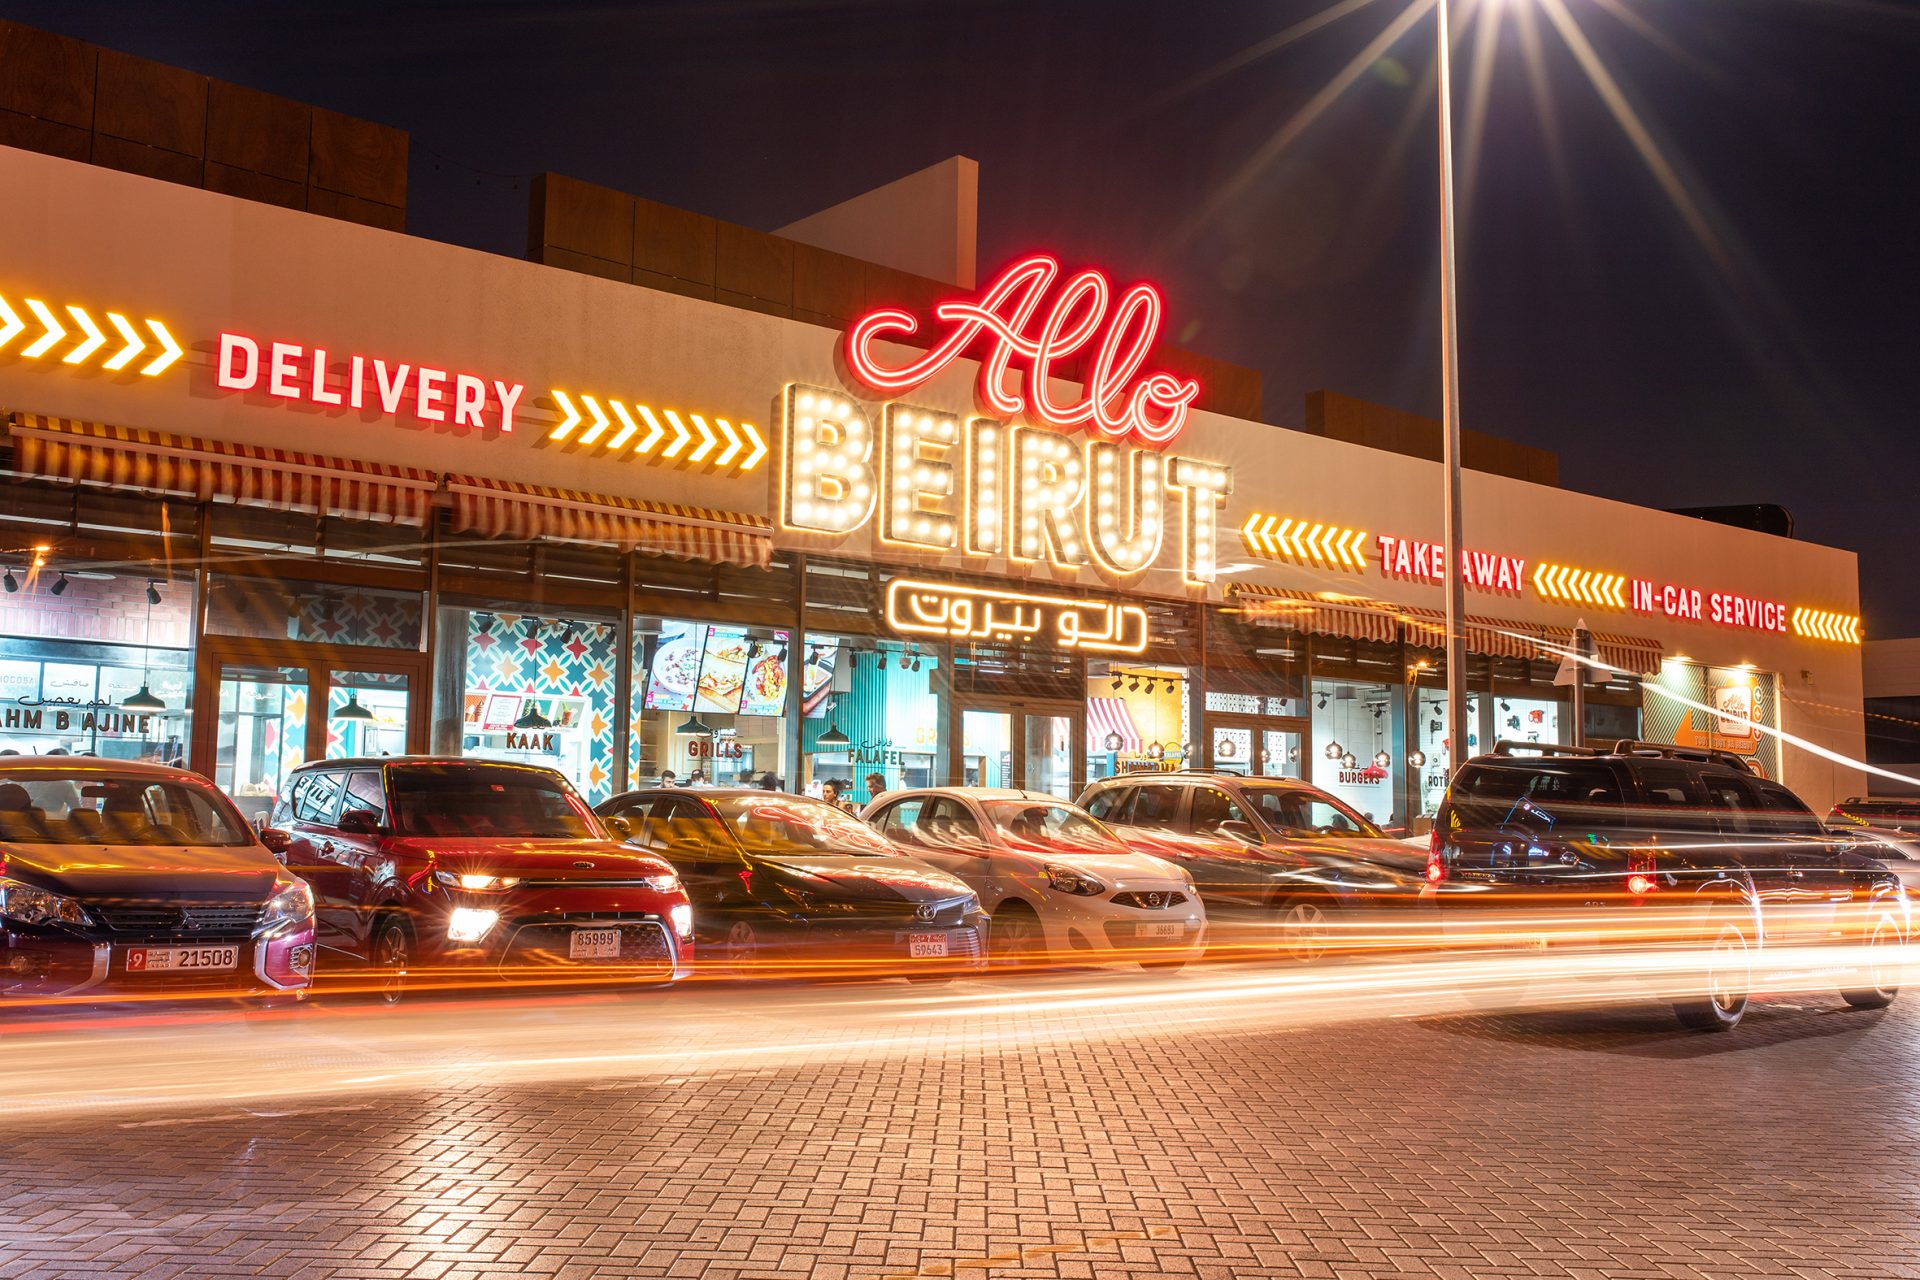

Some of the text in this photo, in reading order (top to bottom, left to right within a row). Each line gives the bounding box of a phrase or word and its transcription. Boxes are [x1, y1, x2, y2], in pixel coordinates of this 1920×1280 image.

[851, 256, 1200, 442] Allo
[217, 332, 524, 433] DELIVERY
[779, 383, 1234, 585] BEIRUT
[1378, 535, 1525, 591] TAKE AWAY
[1632, 579, 1788, 632] IN-CAR SERVICE
[910, 594, 1041, 642] بيروت
[81, 712, 151, 734] AJINE
[506, 732, 553, 751] KAAK
[688, 740, 743, 759] GRILLS
[847, 748, 906, 766] FALAFEL
[1338, 770, 1380, 785] BURGERS
[577, 932, 614, 946] 85999
[133, 953, 143, 968] 9
[179, 949, 233, 967] 21508
[915, 944, 943, 956] 59643
